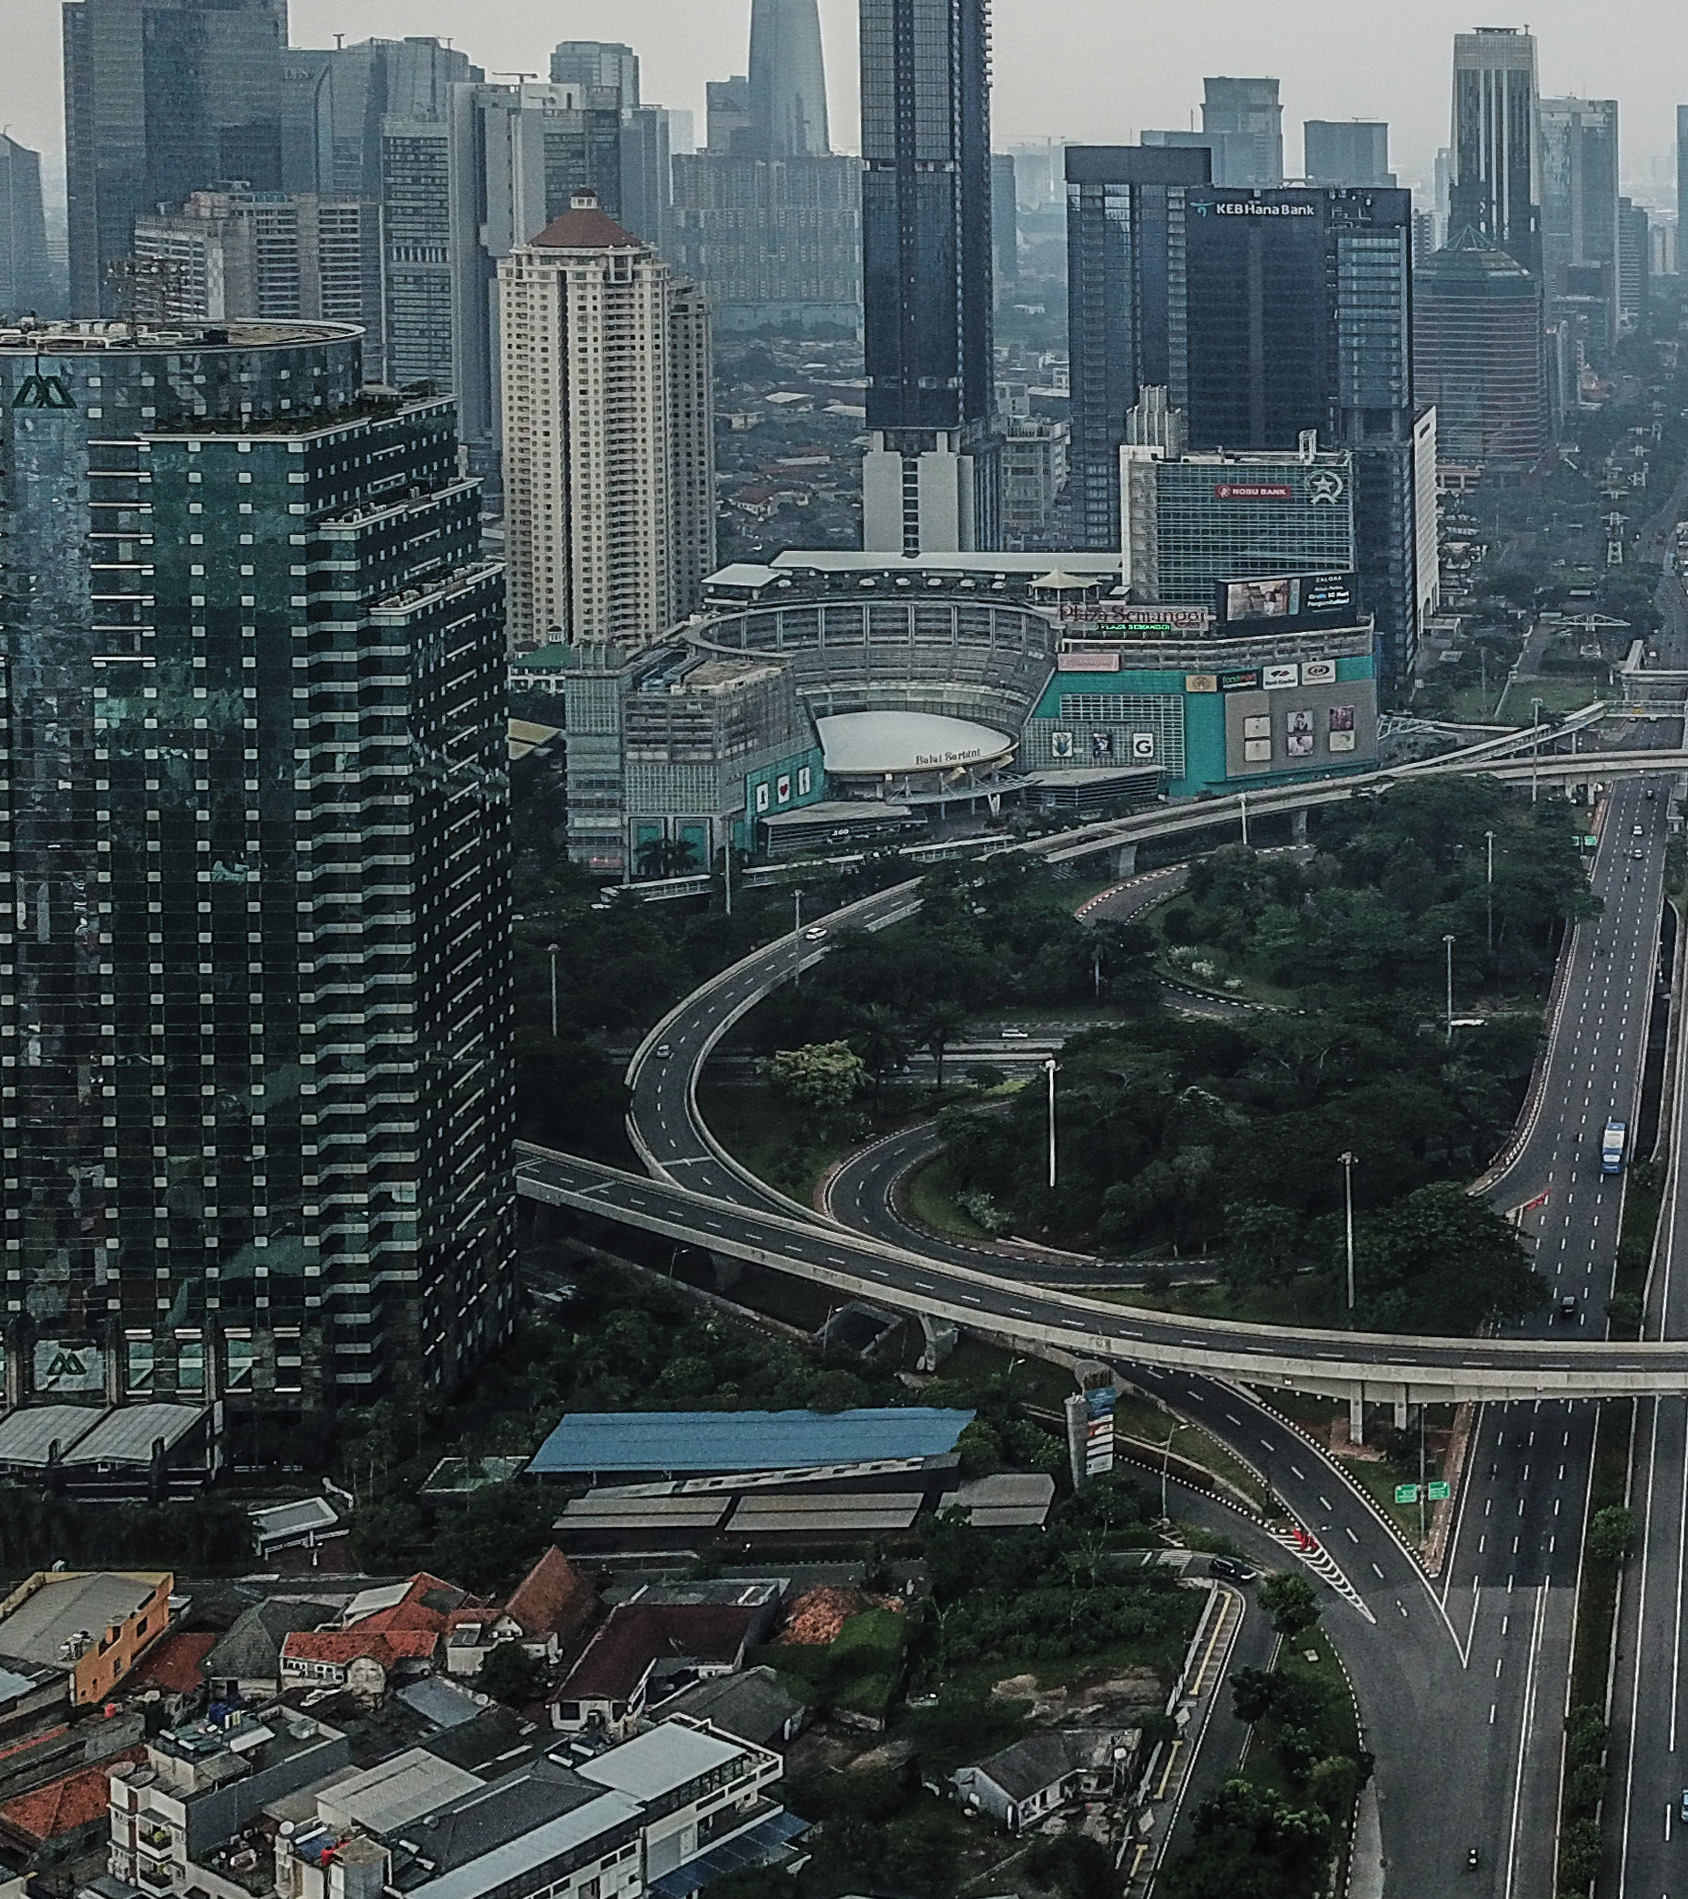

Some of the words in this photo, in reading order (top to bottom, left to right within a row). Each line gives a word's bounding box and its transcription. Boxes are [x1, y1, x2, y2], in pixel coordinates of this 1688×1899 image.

[1216, 203, 1243, 214] KEB
[1245, 203, 1279, 215] Hana
[1281, 204, 1315, 215] Bank
[1232, 488, 1259, 496] NOBU
[1260, 488, 1286, 496] BANK
[1059, 604, 1108, 622] Plaza
[1111, 604, 1206, 629] Semanggi
[916, 754, 943, 765] Balai
